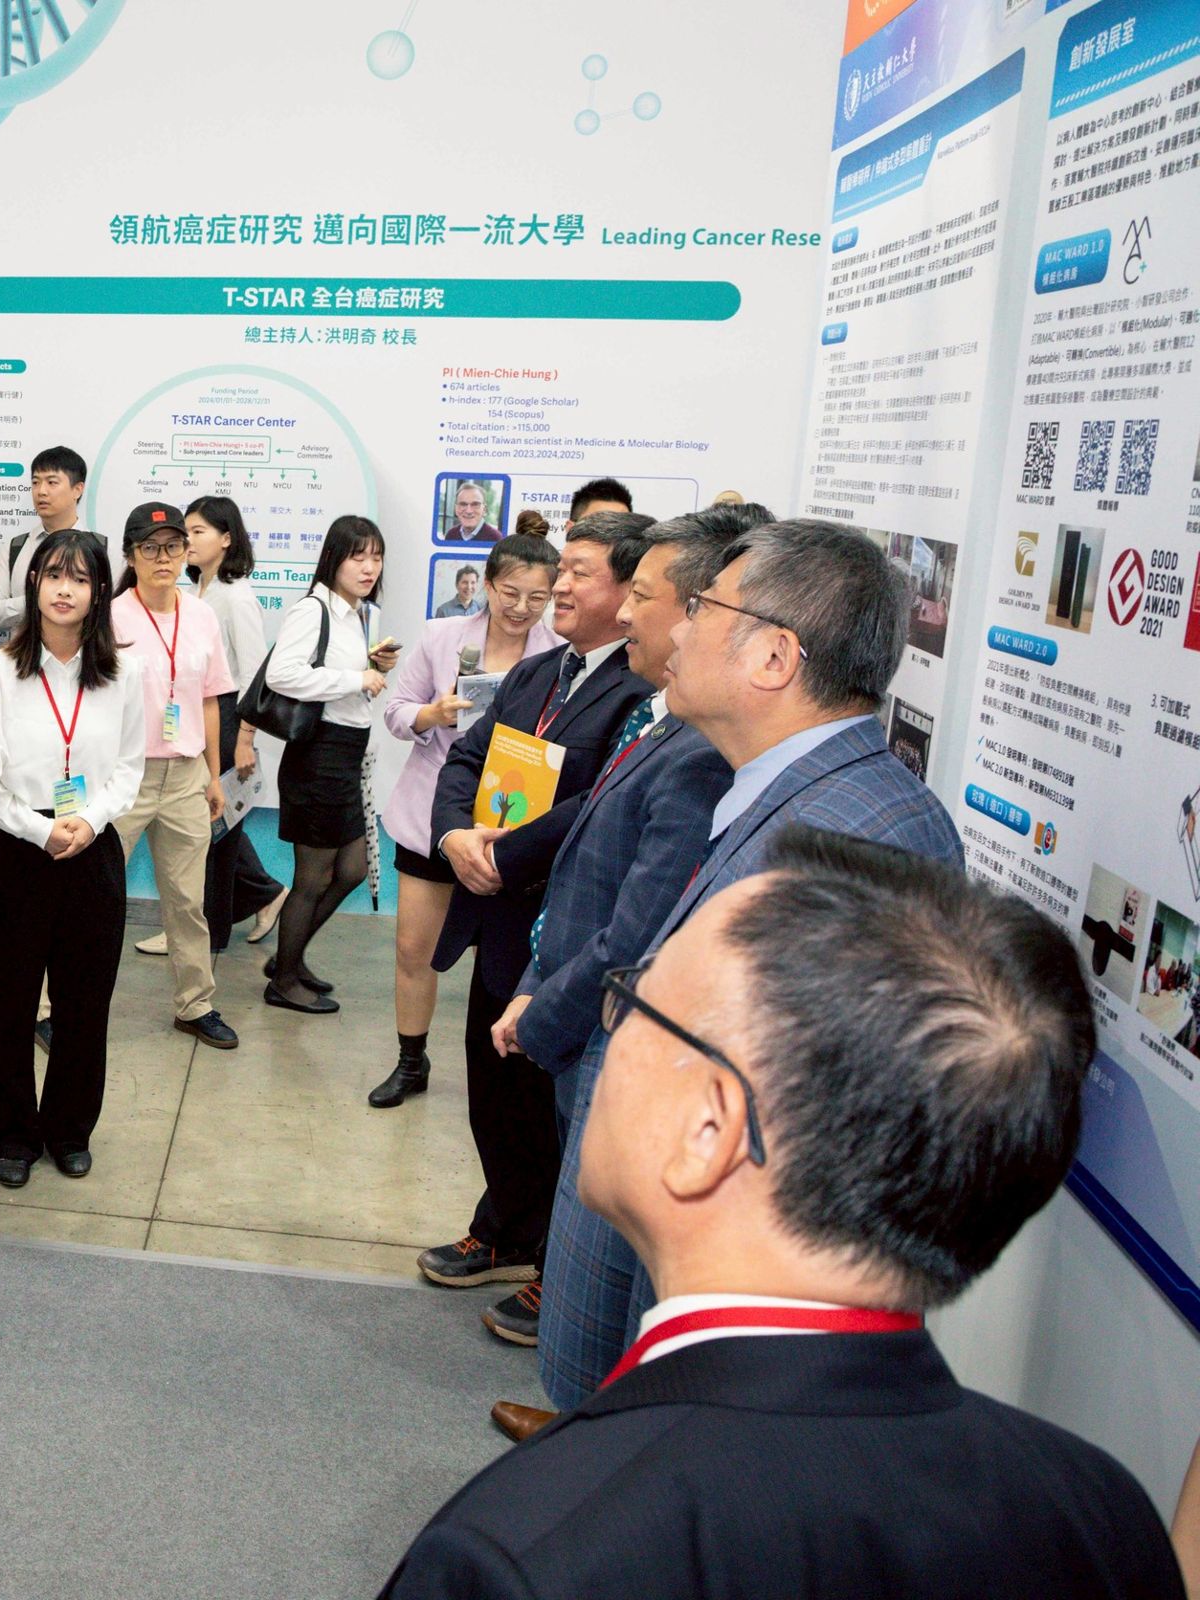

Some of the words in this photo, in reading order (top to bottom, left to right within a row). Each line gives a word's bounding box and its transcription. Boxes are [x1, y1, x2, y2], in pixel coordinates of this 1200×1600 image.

[1069, 17, 1136, 72] 創新發展室
[109, 213, 303, 247] 領航癌症研究
[313, 213, 586, 248] 邁向國際一流大學
[602, 228, 687, 250] Leading
[693, 228, 767, 247] Cancer
[1044, 250, 1064, 265] MAC
[1065, 245, 1089, 261] WARD
[1090, 241, 1104, 255] 1.0
[223, 288, 305, 308] T-STAR
[311, 287, 445, 310] 全台癌症研究
[382, 327, 418, 346] 校長
[442, 368, 454, 378] PI
[463, 368, 520, 379] Mien-Chie
[522, 369, 552, 381] Hung
[211, 387, 236, 397] Funding
[449, 383, 465, 391] 674
[467, 383, 501, 392] articles
[488, 397, 502, 405] 177
[503, 396, 539, 408] (Google
[541, 397, 579, 408] Scholar)
[488, 410, 503, 418] 154
[504, 410, 545, 420] (Scopus)
[172, 415, 211, 426] T-STAR
[214, 416, 254, 427] Cancer
[257, 417, 296, 428] Center
[447, 422, 469, 430] Total
[470, 422, 506, 431] citation
[137, 440, 164, 449] Steering
[301, 445, 329, 454] Advisory
[446, 435, 464, 444] No.1
[466, 436, 490, 445] cited
[491, 437, 522, 446] Taiwan
[523, 438, 562, 447] scientist
[563, 439, 573, 447] in
[574, 439, 616, 448] Medicine
[618, 440, 625, 448] &
[627, 440, 673, 450] Molecular
[674, 441, 710, 452] Biology
[183, 449, 216, 457] Sub-project
[445, 448, 511, 459] (Research.com
[513, 449, 585, 461] 2023,2024,2025)
[137, 479, 169, 487] Academia
[182, 479, 199, 487] CMU
[215, 480, 232, 488] NHRI
[306, 483, 322, 491] TMU
[143, 486, 162, 494] Sinica
[521, 492, 558, 503] T-STAR
[0, 509, 13, 517] and
[268, 541, 291, 550] 副校長
[1150, 549, 1179, 571] GOOD
[249, 570, 286, 581] ream
[1147, 572, 1185, 596] DESIGN
[1144, 594, 1180, 619] AWARD
[1140, 616, 1164, 638] 2021
[993, 632, 1010, 647] MAC
[1011, 635, 1034, 652] WARD
[1035, 642, 1048, 657] 2.0
[985, 738, 998, 752] MAC
[982, 756, 995, 774] MAC
